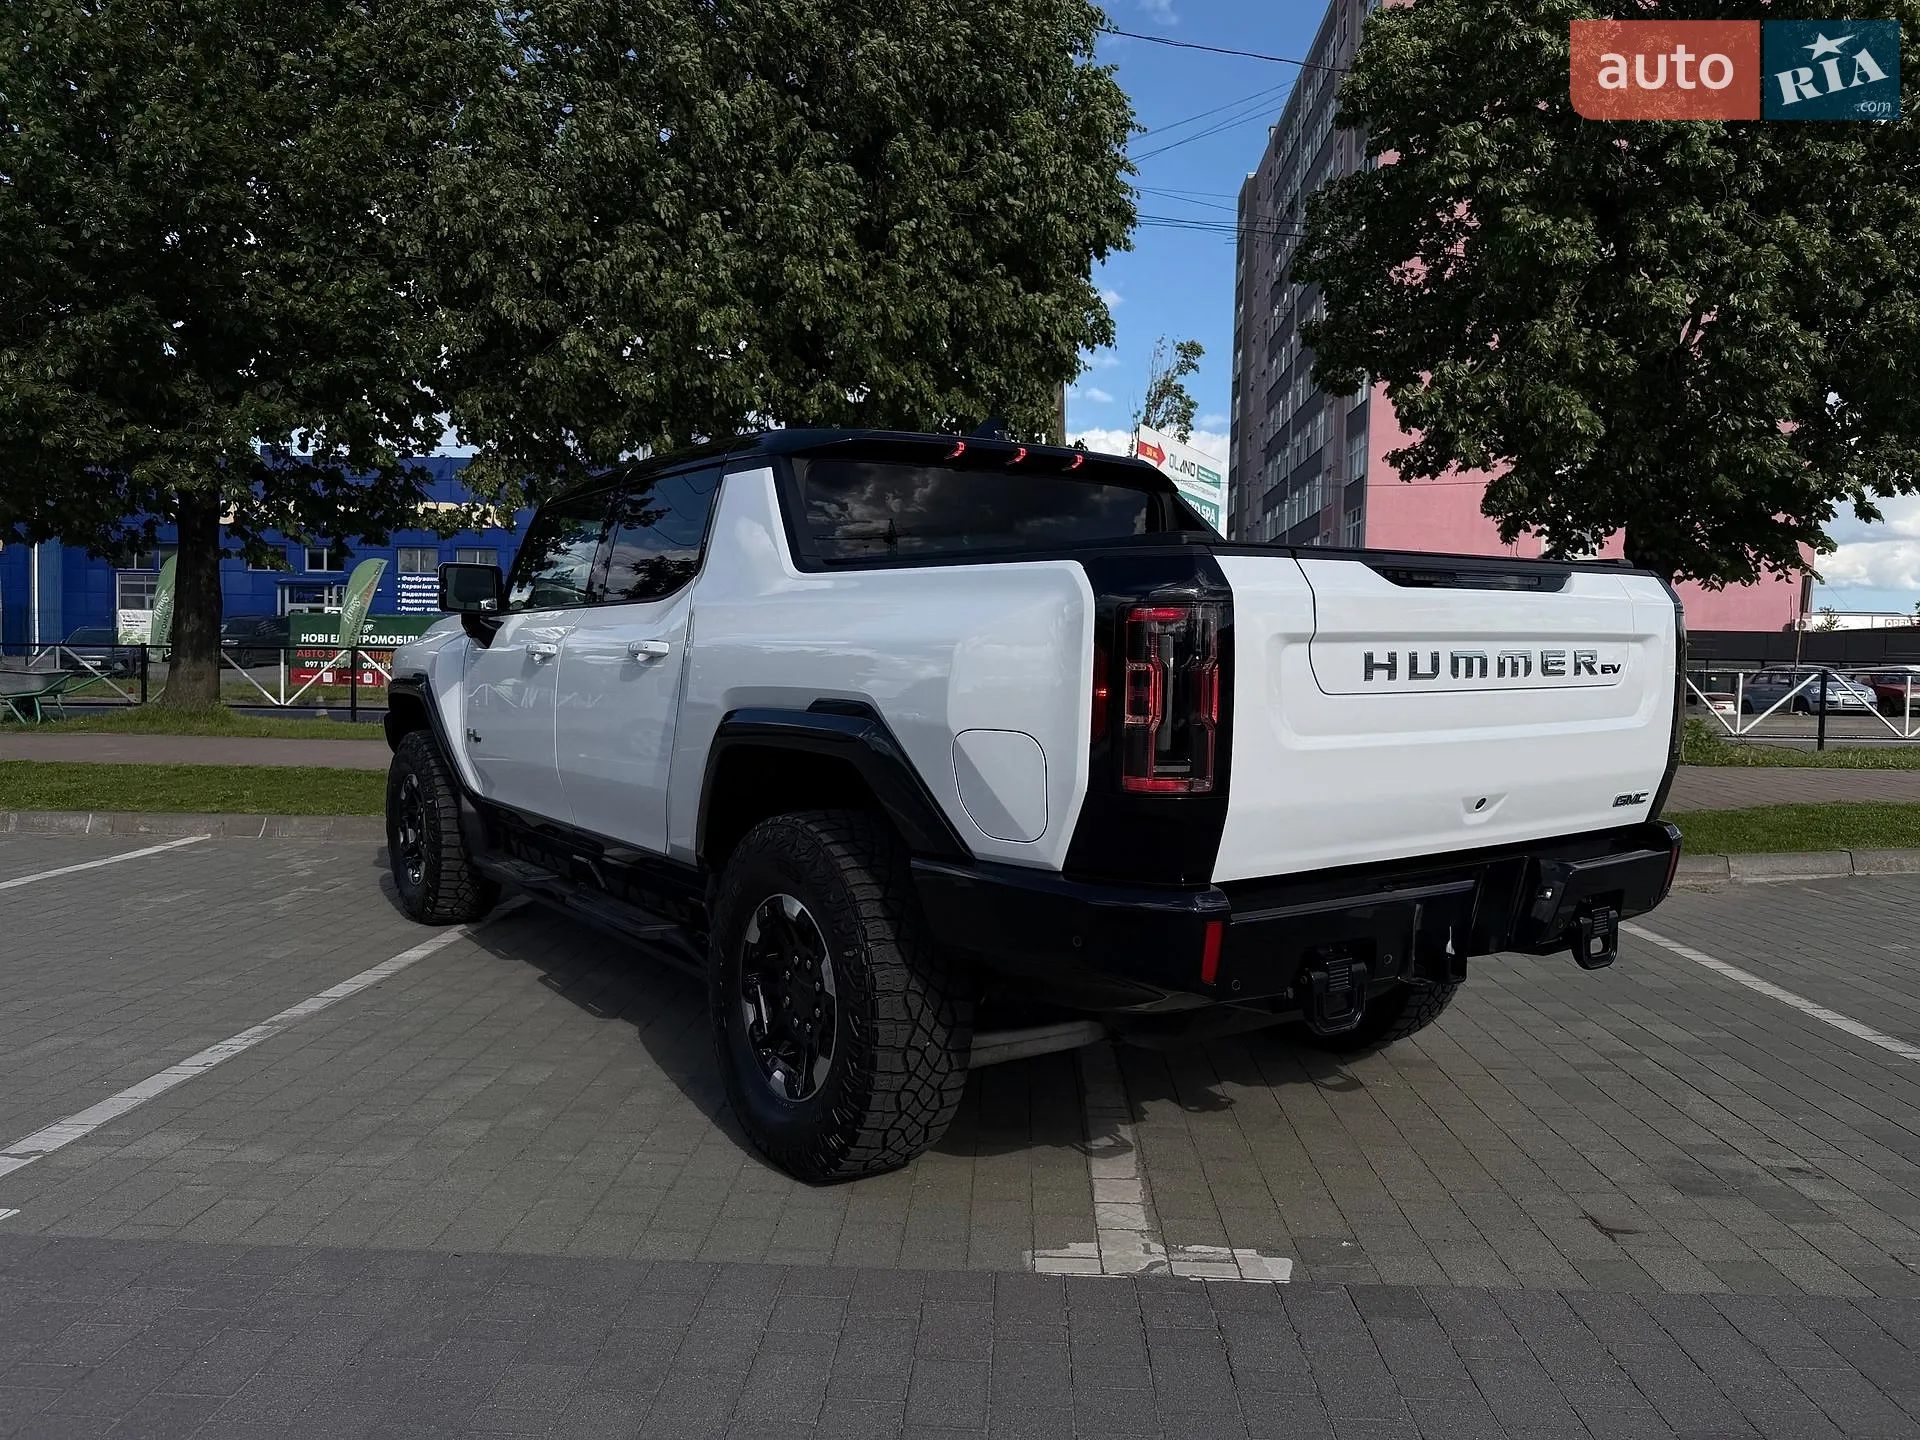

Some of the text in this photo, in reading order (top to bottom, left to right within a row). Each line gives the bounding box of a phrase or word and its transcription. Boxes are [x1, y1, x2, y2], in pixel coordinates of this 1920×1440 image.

[301, 633, 328, 643] НОВІ
[296, 649, 325, 658] АВТО
[1363, 649, 1621, 682] HUMMER EV
[1612, 792, 1649, 808] GMC
